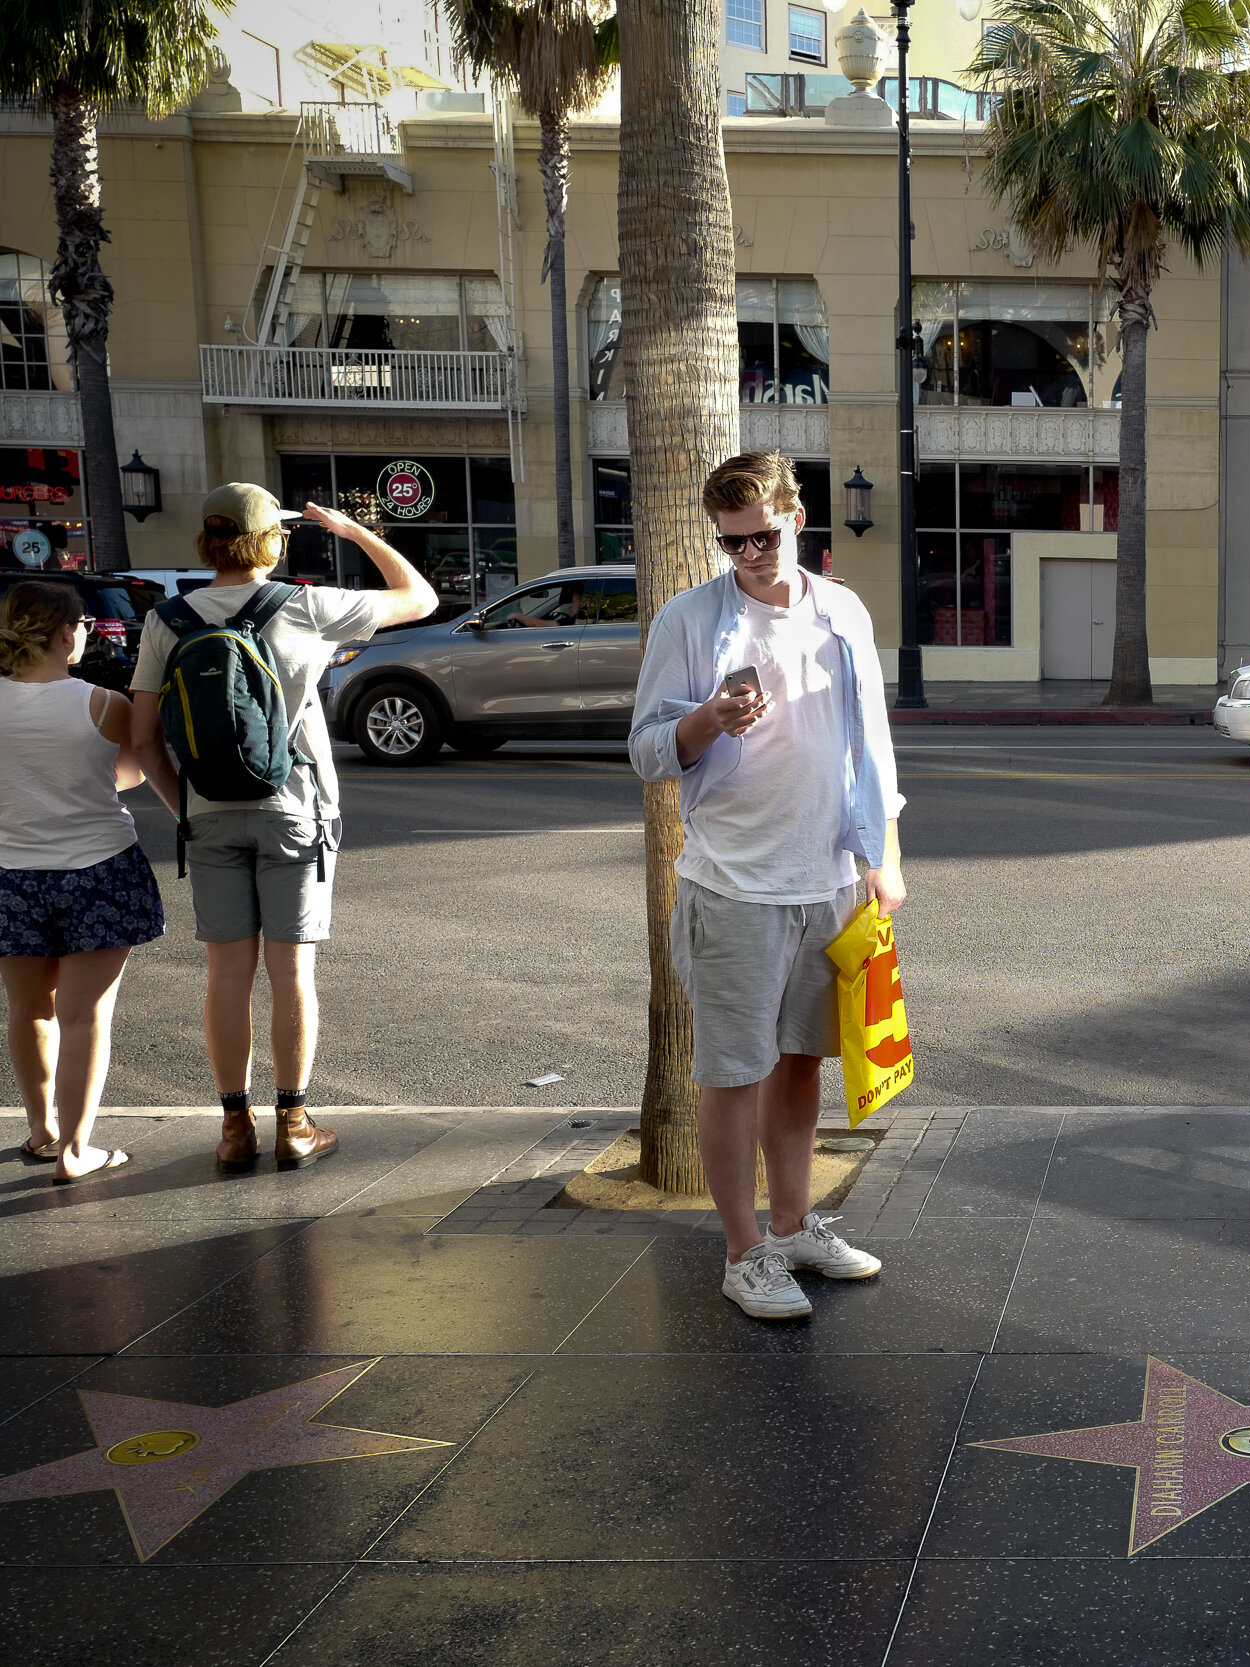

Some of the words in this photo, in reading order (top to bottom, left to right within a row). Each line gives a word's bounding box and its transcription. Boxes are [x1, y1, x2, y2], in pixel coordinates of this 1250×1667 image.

[388, 462, 421, 476] OPEN
[0, 485, 65, 501] URGERS
[392, 483, 418, 497] 25°
[381, 495, 395, 509] 24
[397, 495, 431, 516] HOURS
[857, 1077, 891, 1110] DON'T
[894, 1059, 912, 1084] PAY
[1156, 1384, 1187, 1444] CARROLL
[1150, 1449, 1184, 1516] DIAHANN
